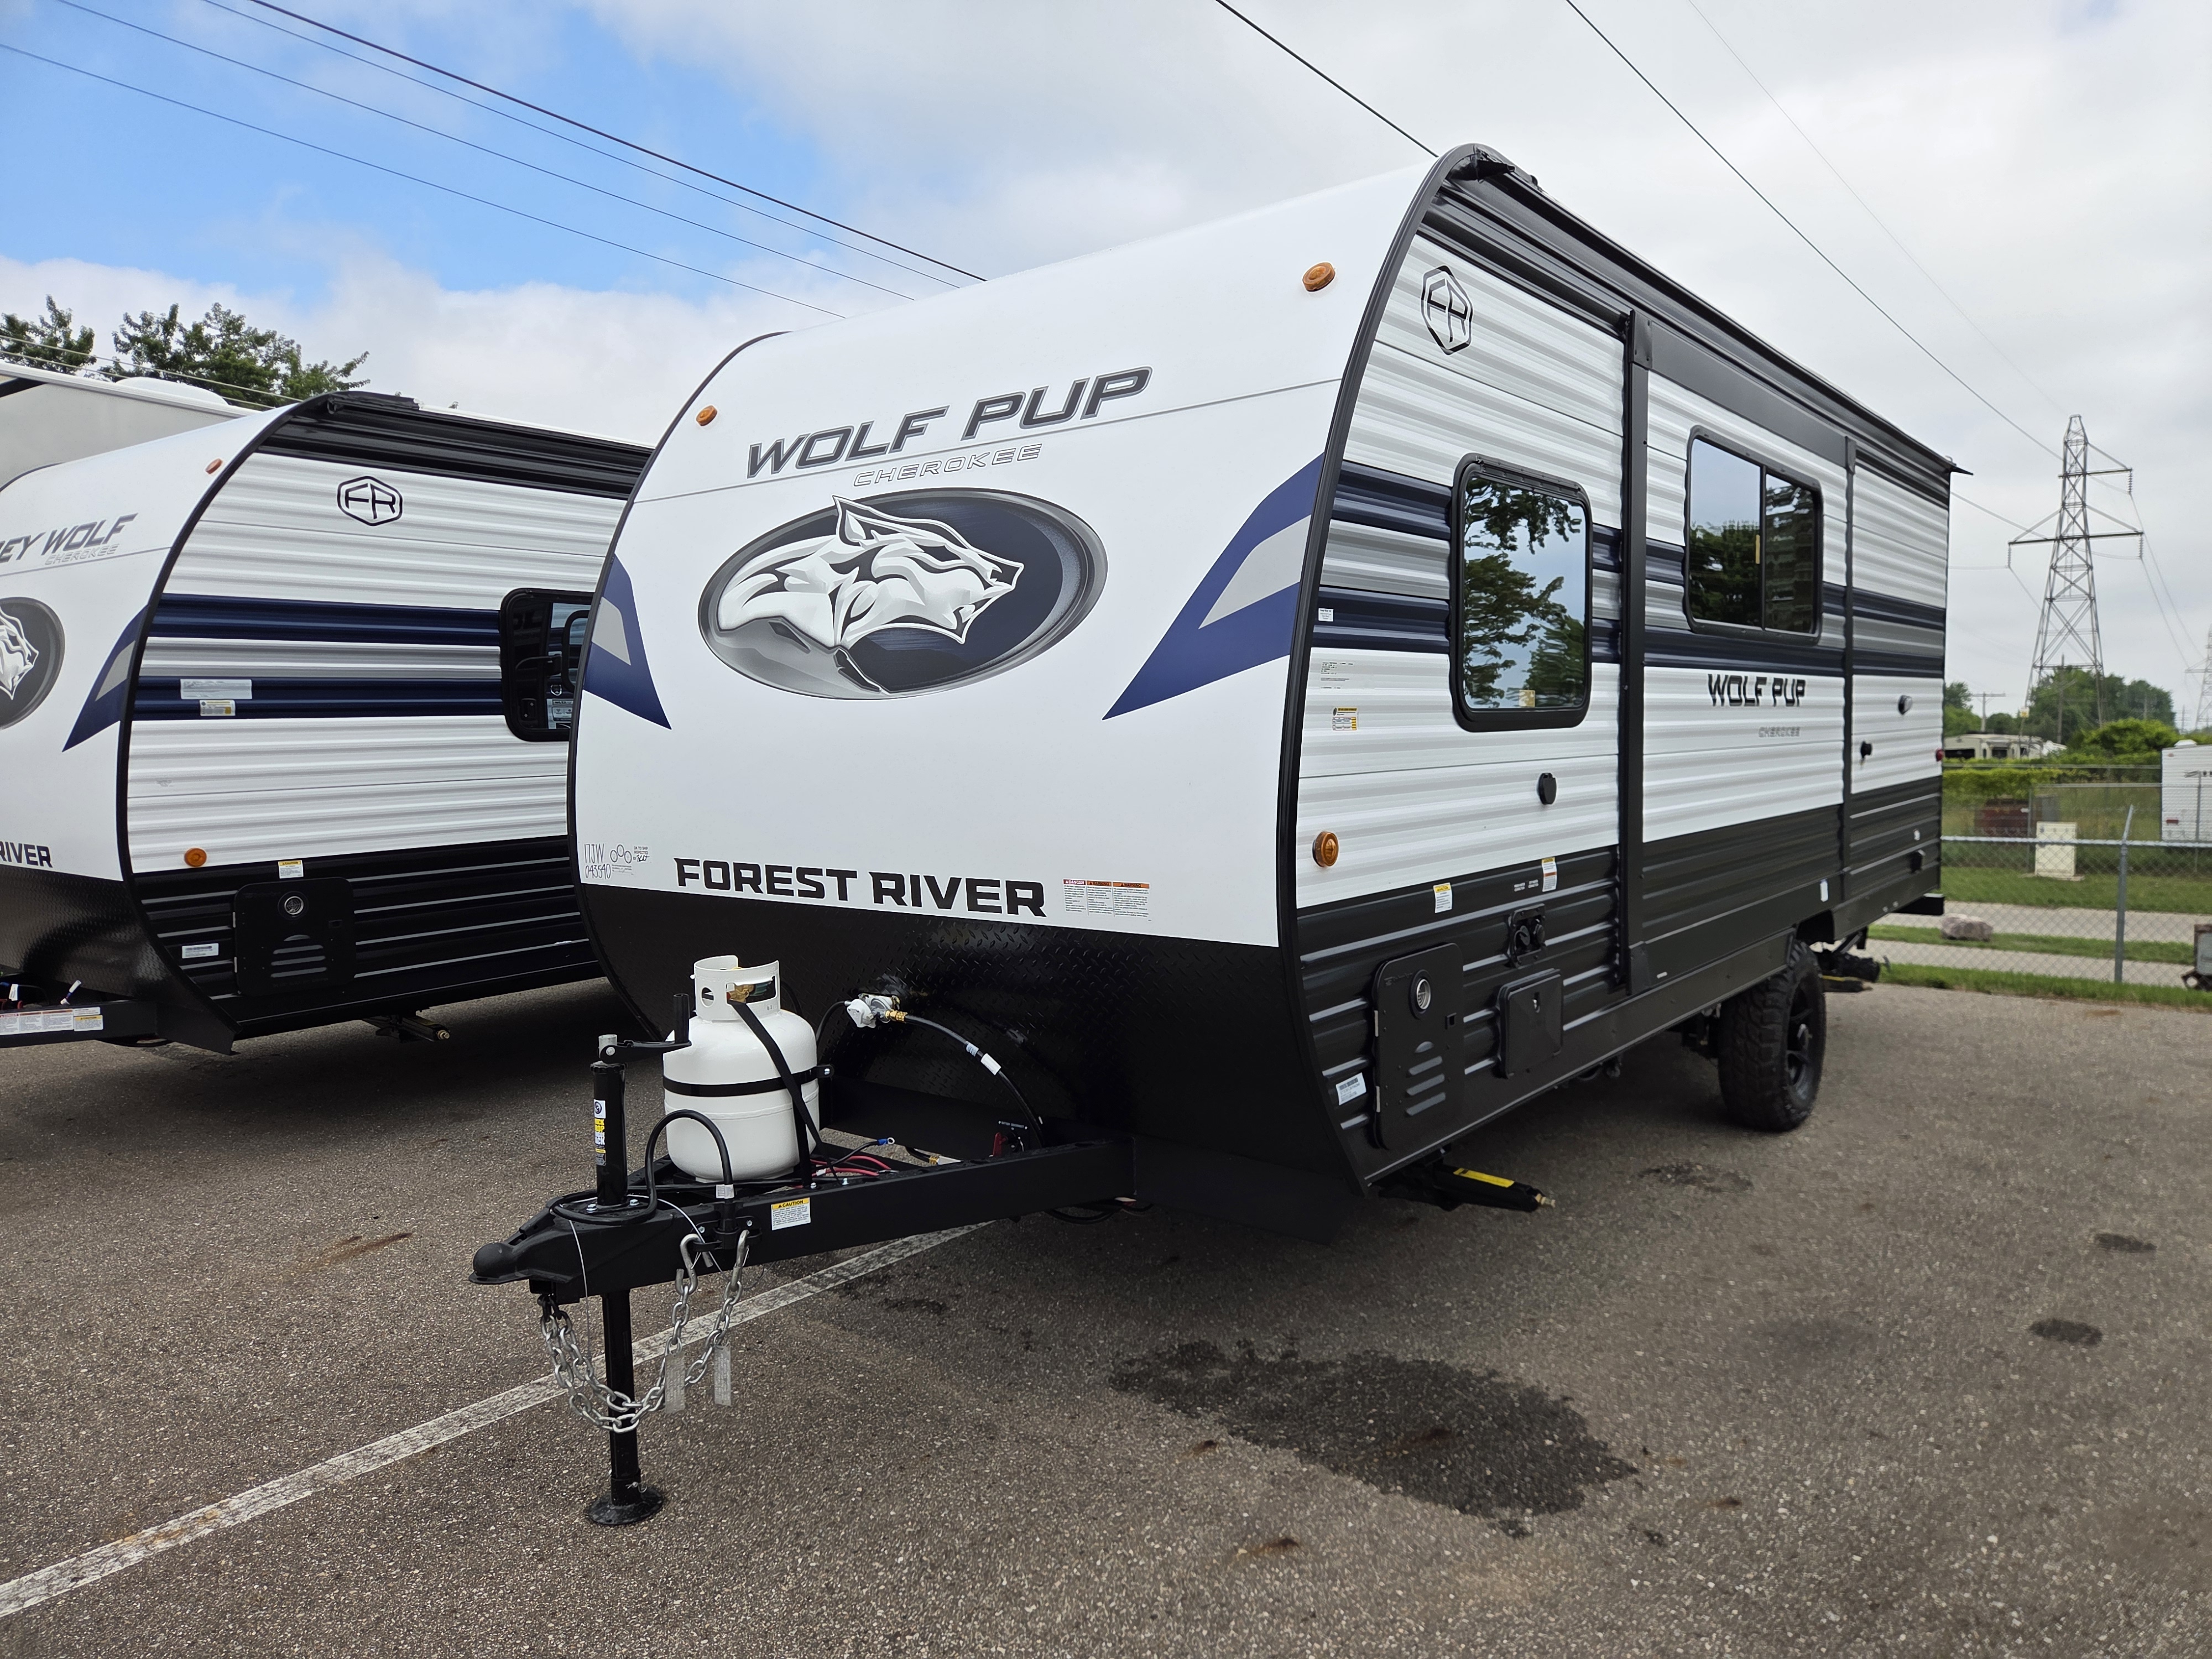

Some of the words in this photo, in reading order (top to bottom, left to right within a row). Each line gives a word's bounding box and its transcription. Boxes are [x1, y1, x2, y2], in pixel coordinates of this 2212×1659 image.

[747, 405, 950, 479] WOLF
[961, 366, 1153, 441] PUP
[853, 443, 1042, 487] CHEROKEE
[0, 532, 46, 564] EY
[41, 513, 138, 556] WOLF
[44, 543, 119, 565] CHEROKEE
[1707, 673, 1767, 707] WOLF
[1772, 677, 1806, 707] PUP
[673, 858, 858, 901] FOREST
[868, 871, 1047, 917] RIVER
[782, 1199, 804, 1208] CAUTION
